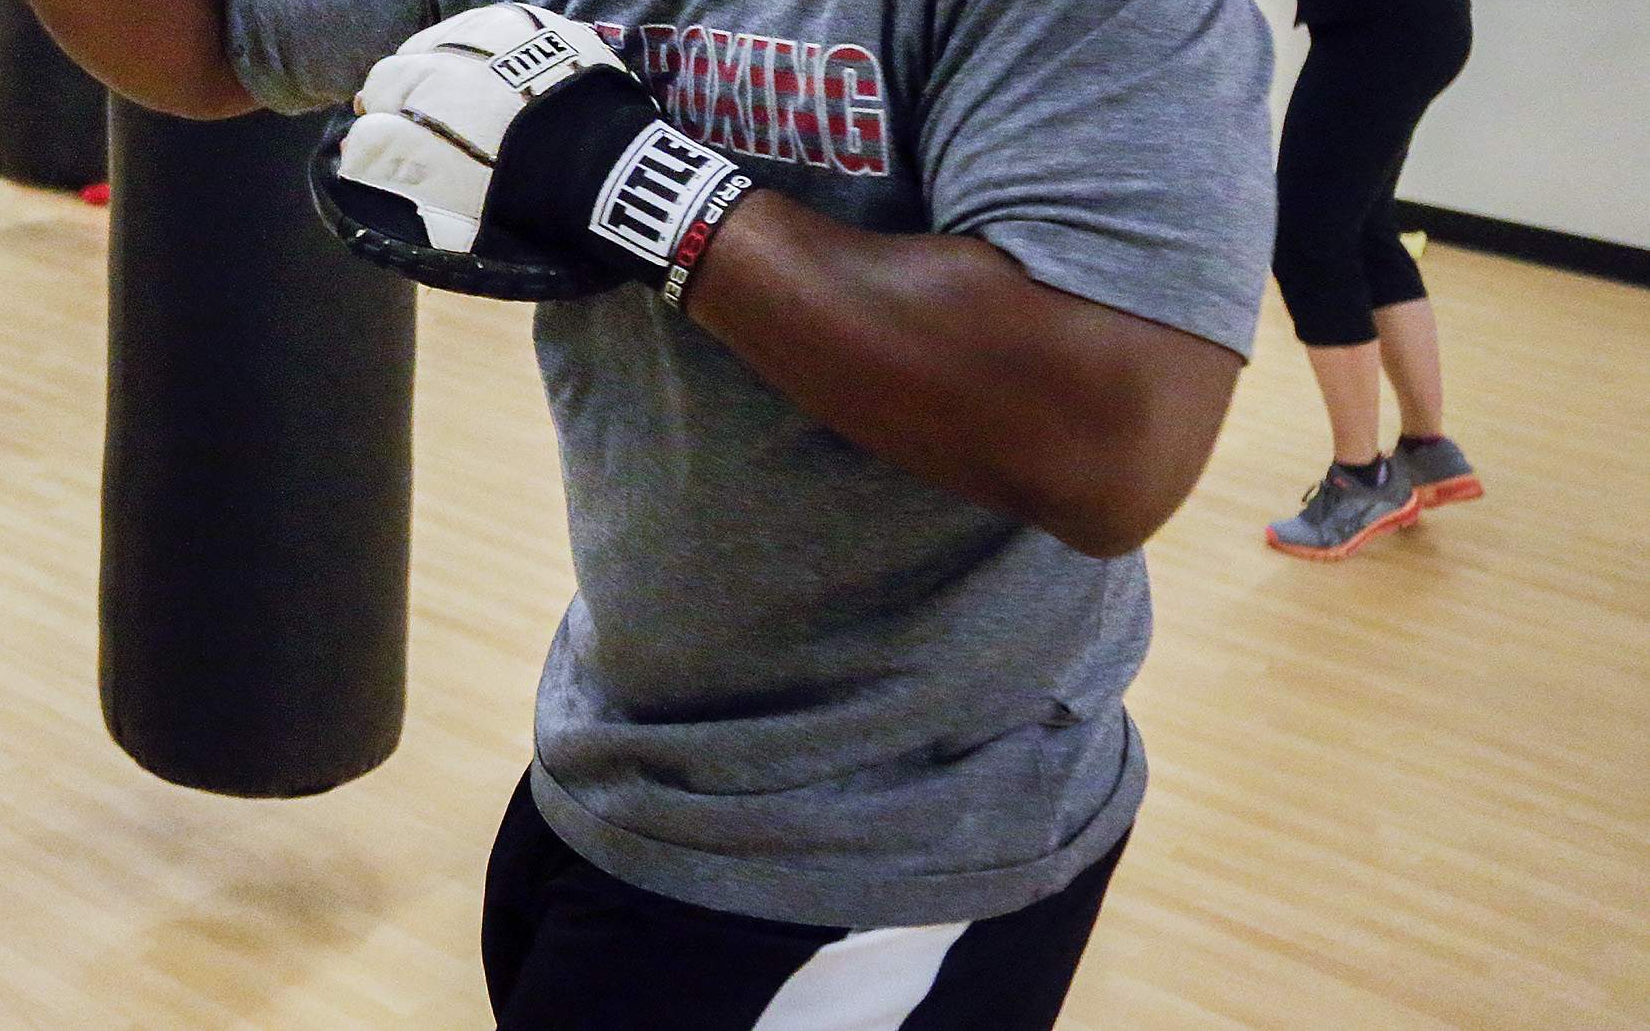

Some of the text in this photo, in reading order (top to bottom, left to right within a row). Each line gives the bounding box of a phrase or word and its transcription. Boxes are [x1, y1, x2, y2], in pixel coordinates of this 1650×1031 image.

[497, 35, 568, 78] TITLE
[640, 24, 889, 177] BOXING
[607, 135, 711, 244] TITLE
[703, 174, 753, 225] GRIP
